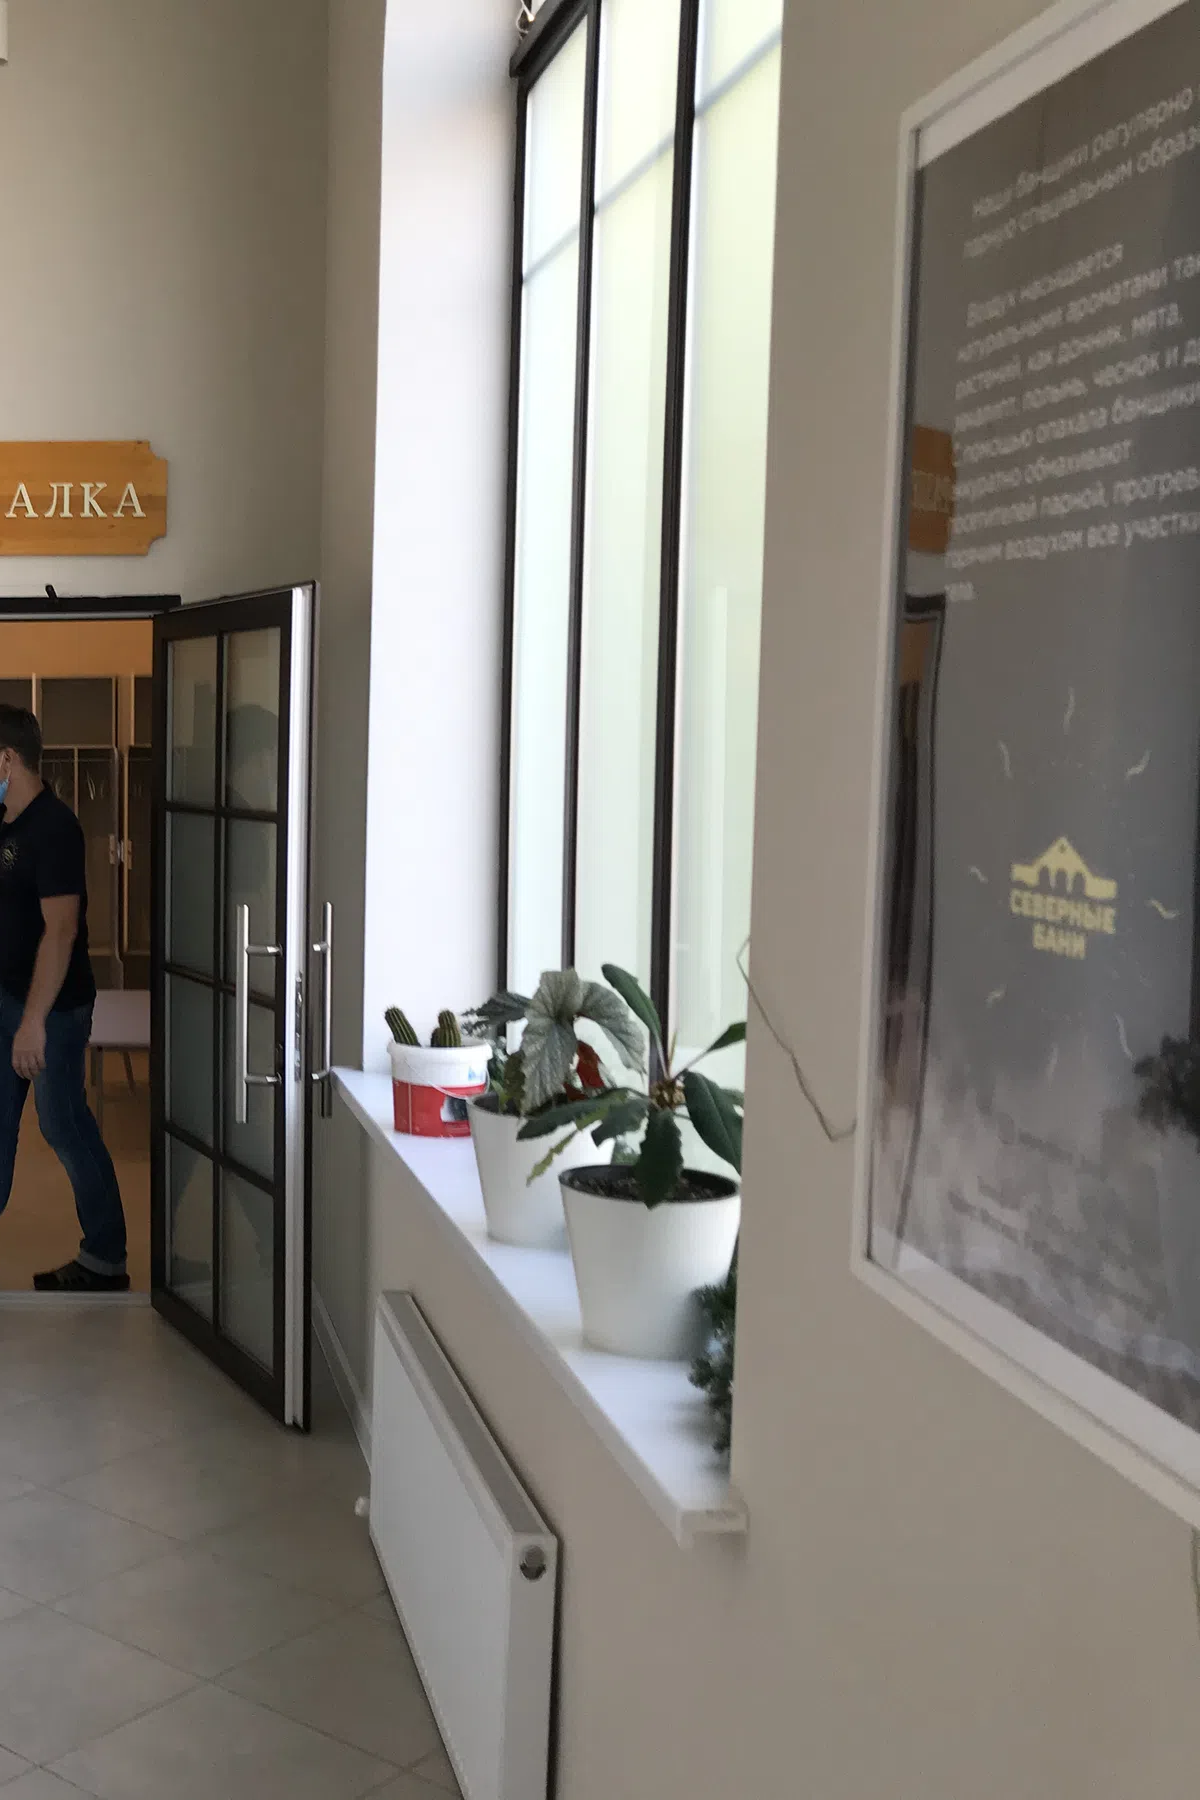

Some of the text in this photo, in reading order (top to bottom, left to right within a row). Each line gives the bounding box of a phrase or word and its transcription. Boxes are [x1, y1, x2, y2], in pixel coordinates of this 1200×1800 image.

[1092, 87, 1193, 158] регулярно
[1066, 267, 1167, 322] ароматами
[1131, 303, 1183, 338] мята,
[1036, 407, 1108, 443] опахала
[1087, 522, 1119, 548] все
[1010, 888, 1116, 935] СЕВЕРНЫЕ
[1033, 922, 1086, 960] БАНИ
